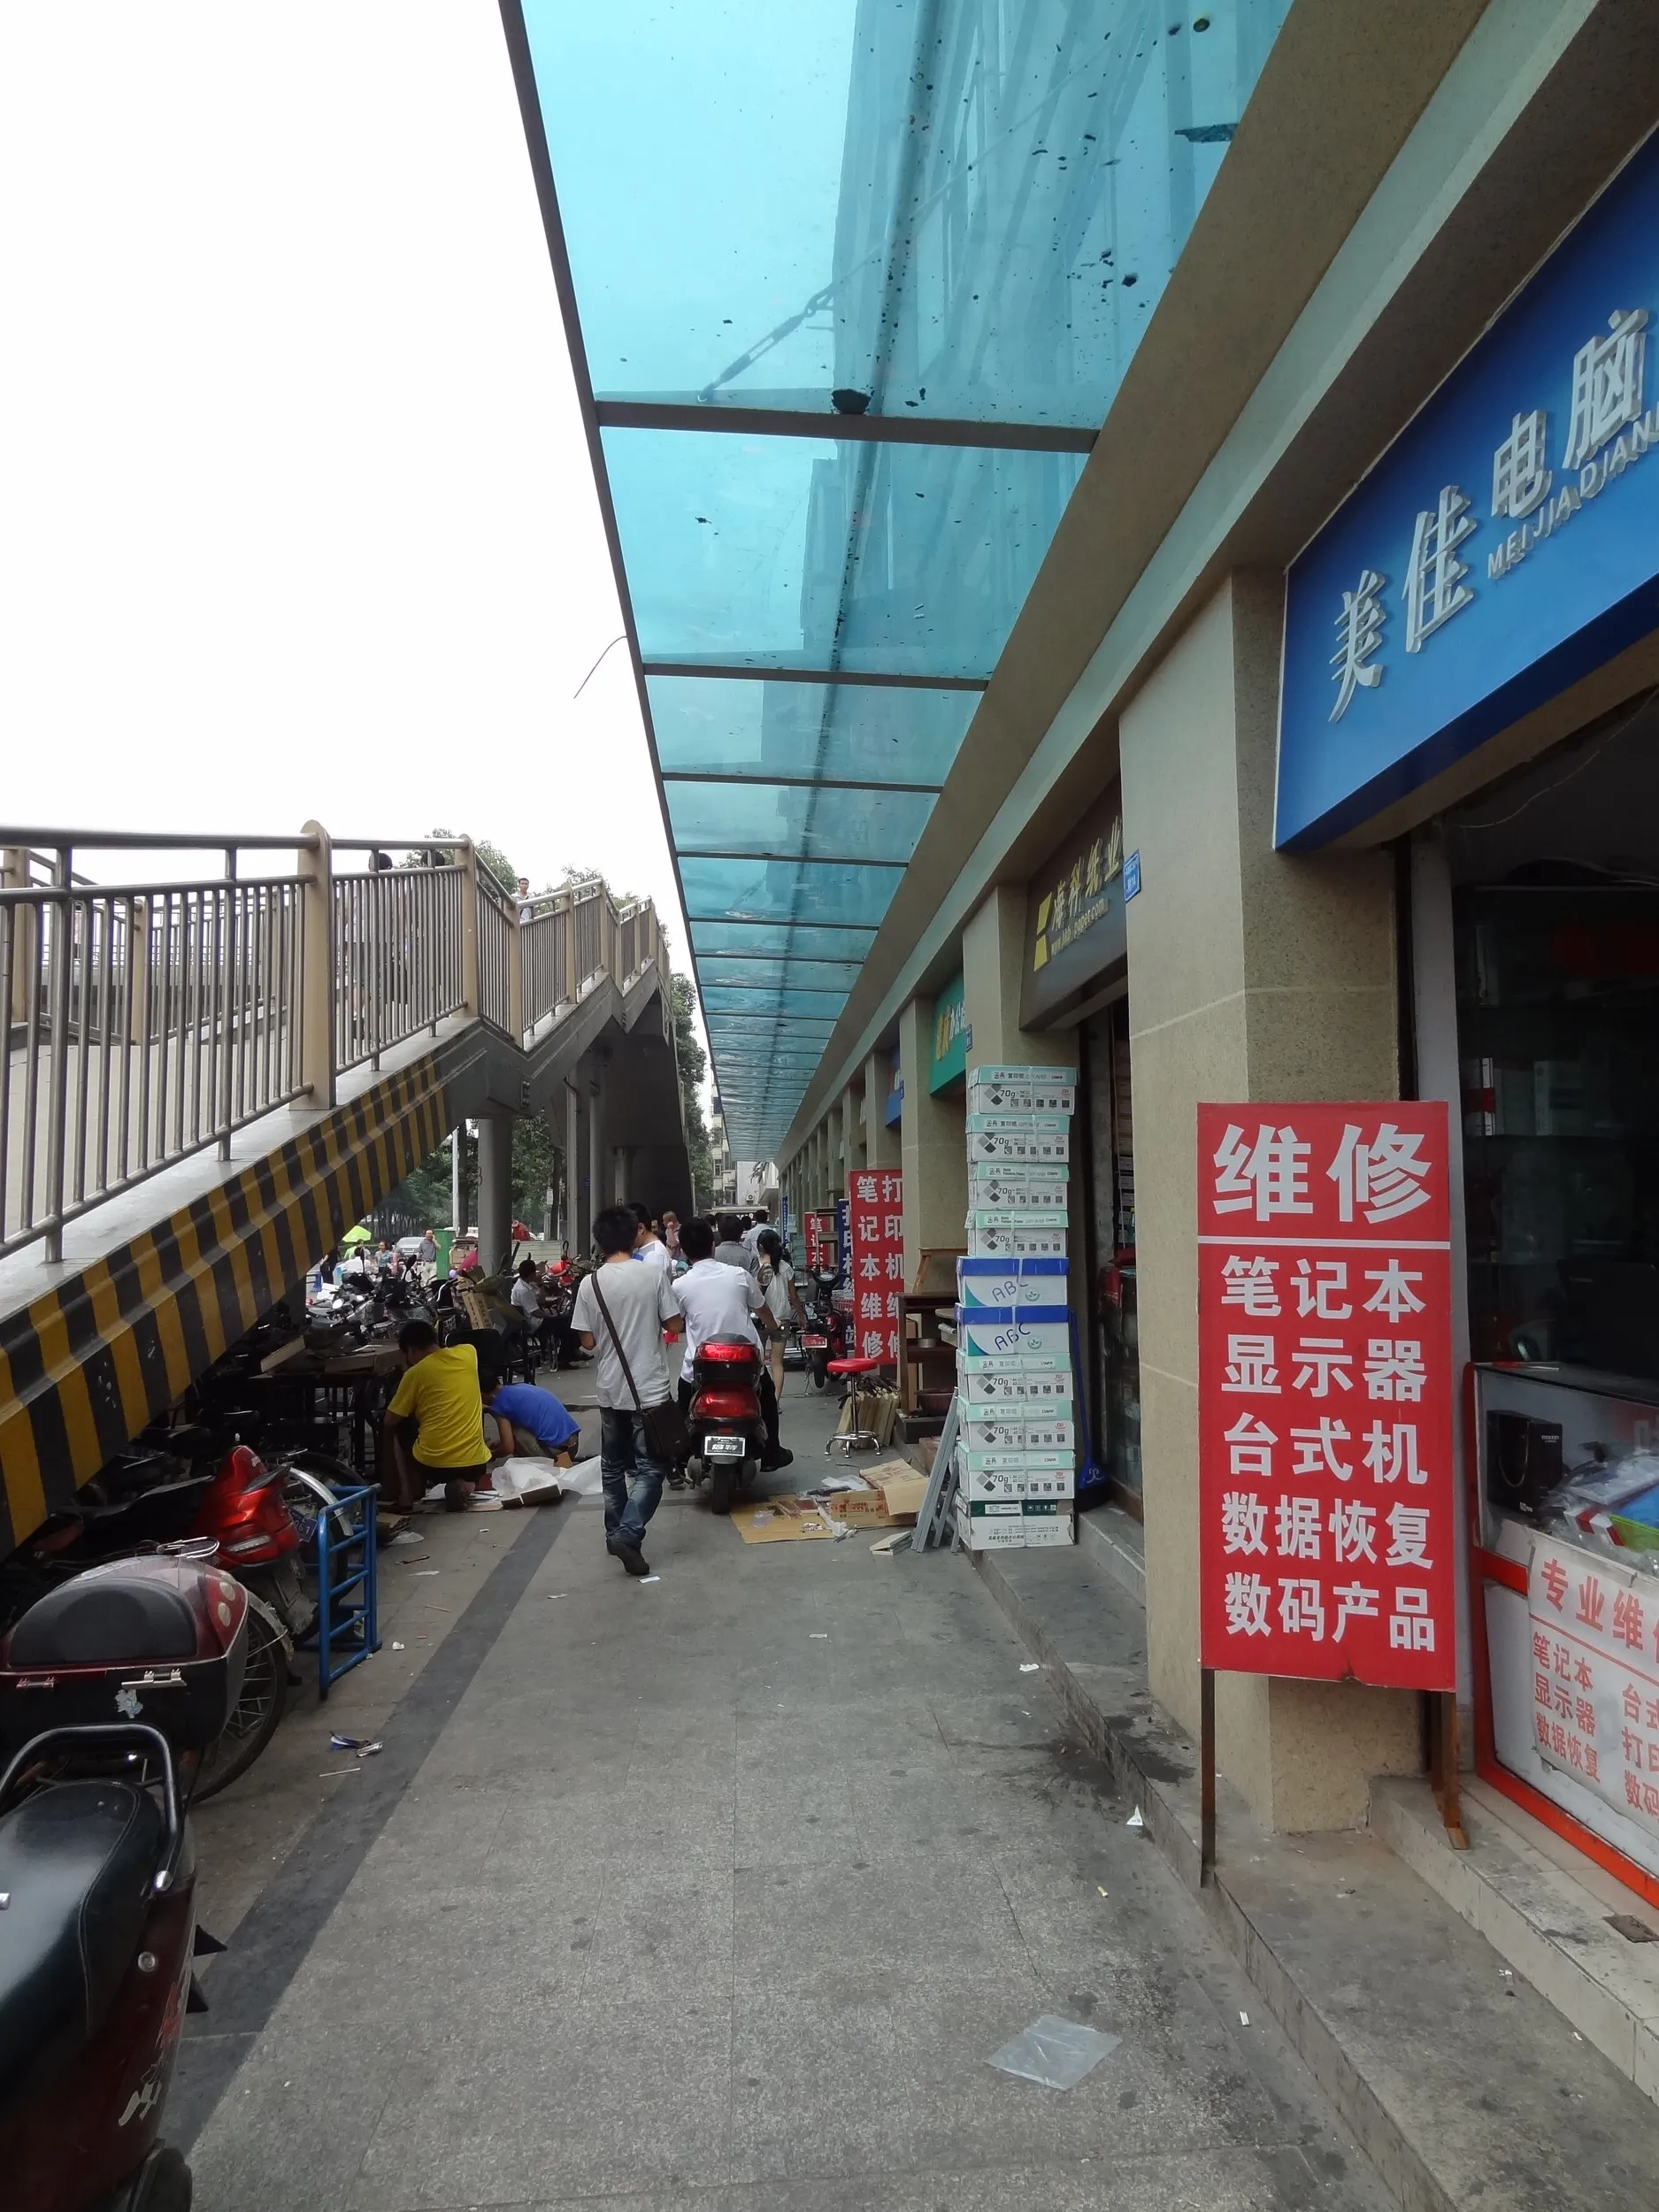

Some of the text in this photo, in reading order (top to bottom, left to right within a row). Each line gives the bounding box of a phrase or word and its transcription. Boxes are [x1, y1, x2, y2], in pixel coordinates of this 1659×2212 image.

[1328, 308, 1648, 722] 美佳电脑
[1488, 403, 1659, 579] MEIJIADIAN
[1000, 1089, 1016, 1098] 70g
[994, 1137, 1009, 1146] 70g
[1212, 1123, 1432, 1225] 维修
[856, 1176, 884, 1358] 笔记本维修
[1220, 1256, 1426, 1324] 笔记本
[1221, 1334, 1427, 1402] 显示器
[993, 1426, 1009, 1435] 70g
[1223, 1412, 1428, 1486] 台式机
[992, 1474, 1009, 1483] 70g
[1221, 1491, 1433, 1570] 数据恢复
[1224, 1571, 1435, 1652] 数码产品
[1540, 1558, 1659, 1663] 专业维
[1532, 1632, 1594, 1692] 笔记本
[1534, 1671, 1596, 1737] 显示器
[1535, 1712, 1601, 1783] 数据恢复
